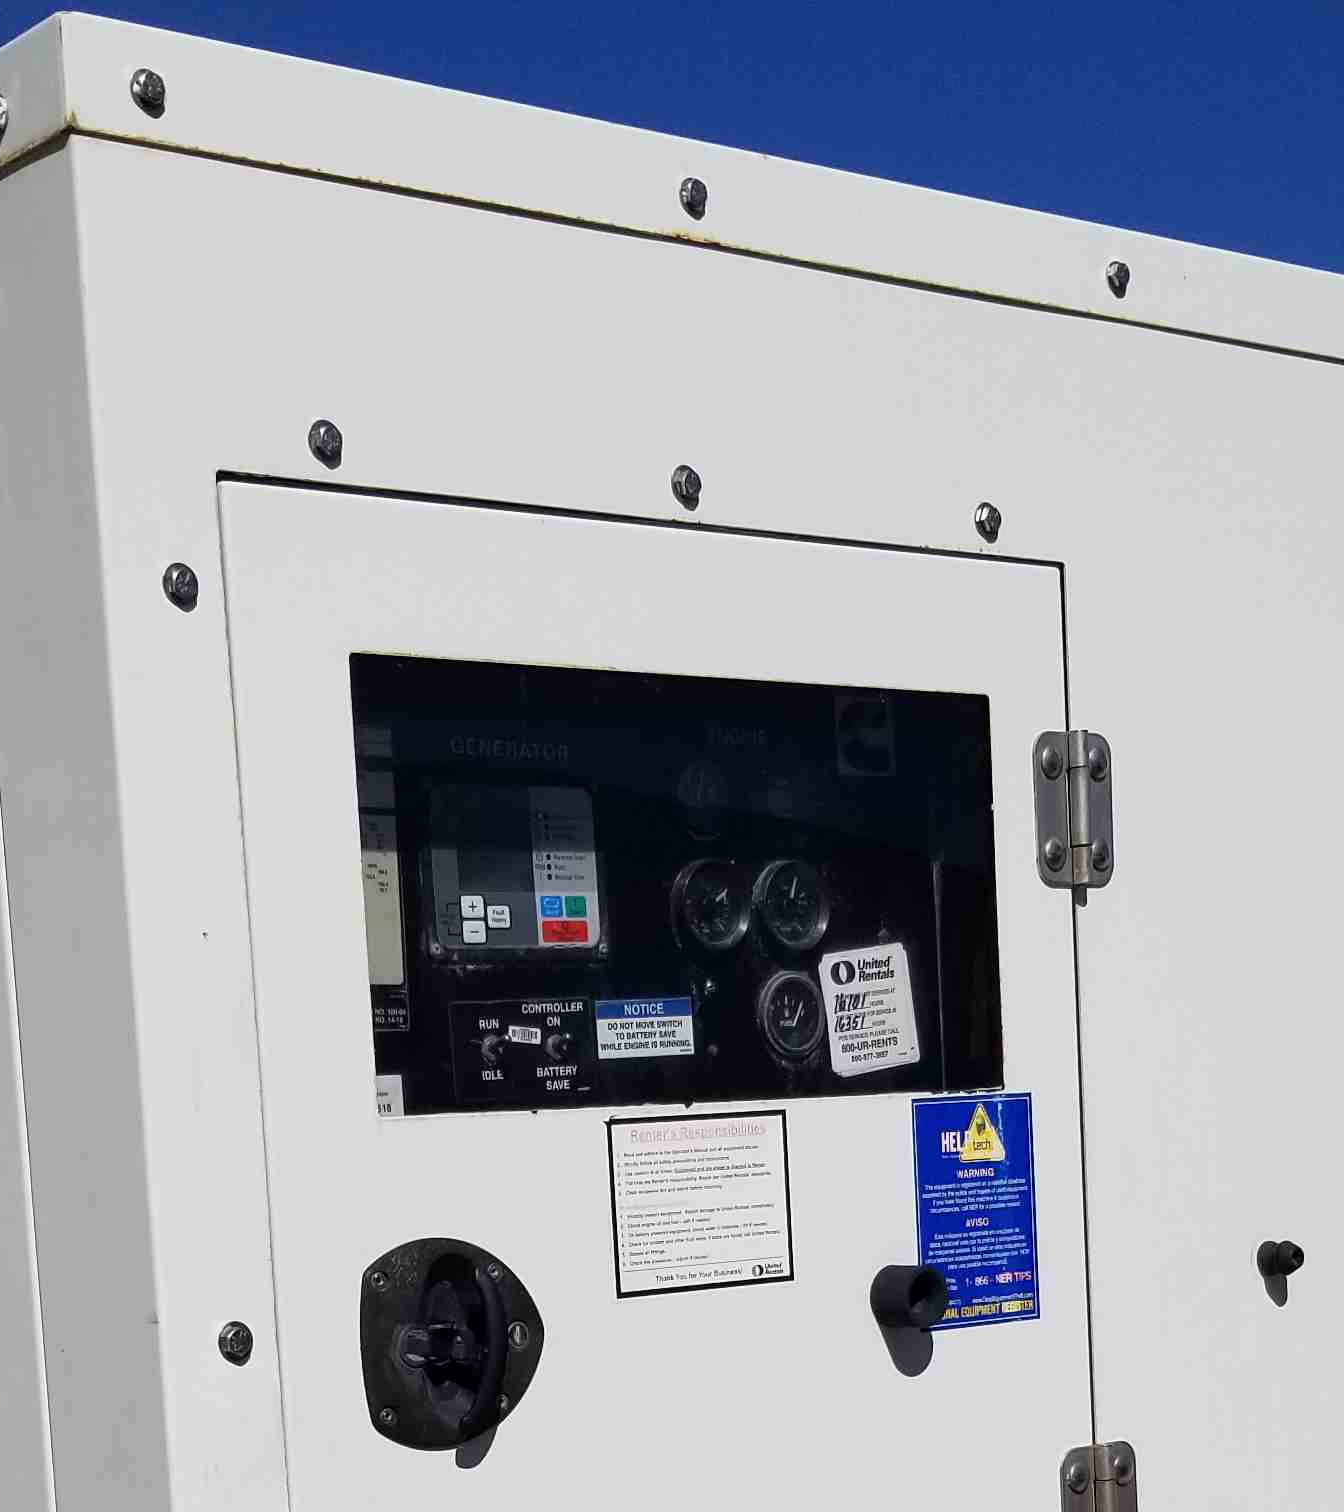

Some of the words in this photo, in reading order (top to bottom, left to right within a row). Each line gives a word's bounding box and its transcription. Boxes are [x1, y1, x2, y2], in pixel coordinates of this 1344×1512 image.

[857, 956, 891, 971] United
[858, 968, 895, 982] Rentals
[521, 1002, 584, 1014] CONTROLLER
[624, 1003, 665, 1016] NOTICE
[479, 1018, 500, 1029] RUN
[547, 1016, 561, 1027] ON
[607, 1021, 618, 1030] DO
[620, 1021, 634, 1030] NOT
[635, 1020, 654, 1029] MOVE
[656, 1019, 683, 1029] SWITCH
[616, 1031, 624, 1039] TO
[626, 1030, 657, 1039] BATTERY
[659, 1030, 676, 1039] SAVE
[600, 1043, 621, 1052] WHILE
[623, 1041, 649, 1051] ENGINE
[651, 1041, 657, 1049] IS
[482, 1071, 504, 1081] IDLE
[536, 1065, 578, 1078] BATTERY
[546, 1080, 571, 1090] SAVE
[957, 1168, 995, 1178] WARNING
[965, 1217, 989, 1228] AVISO
